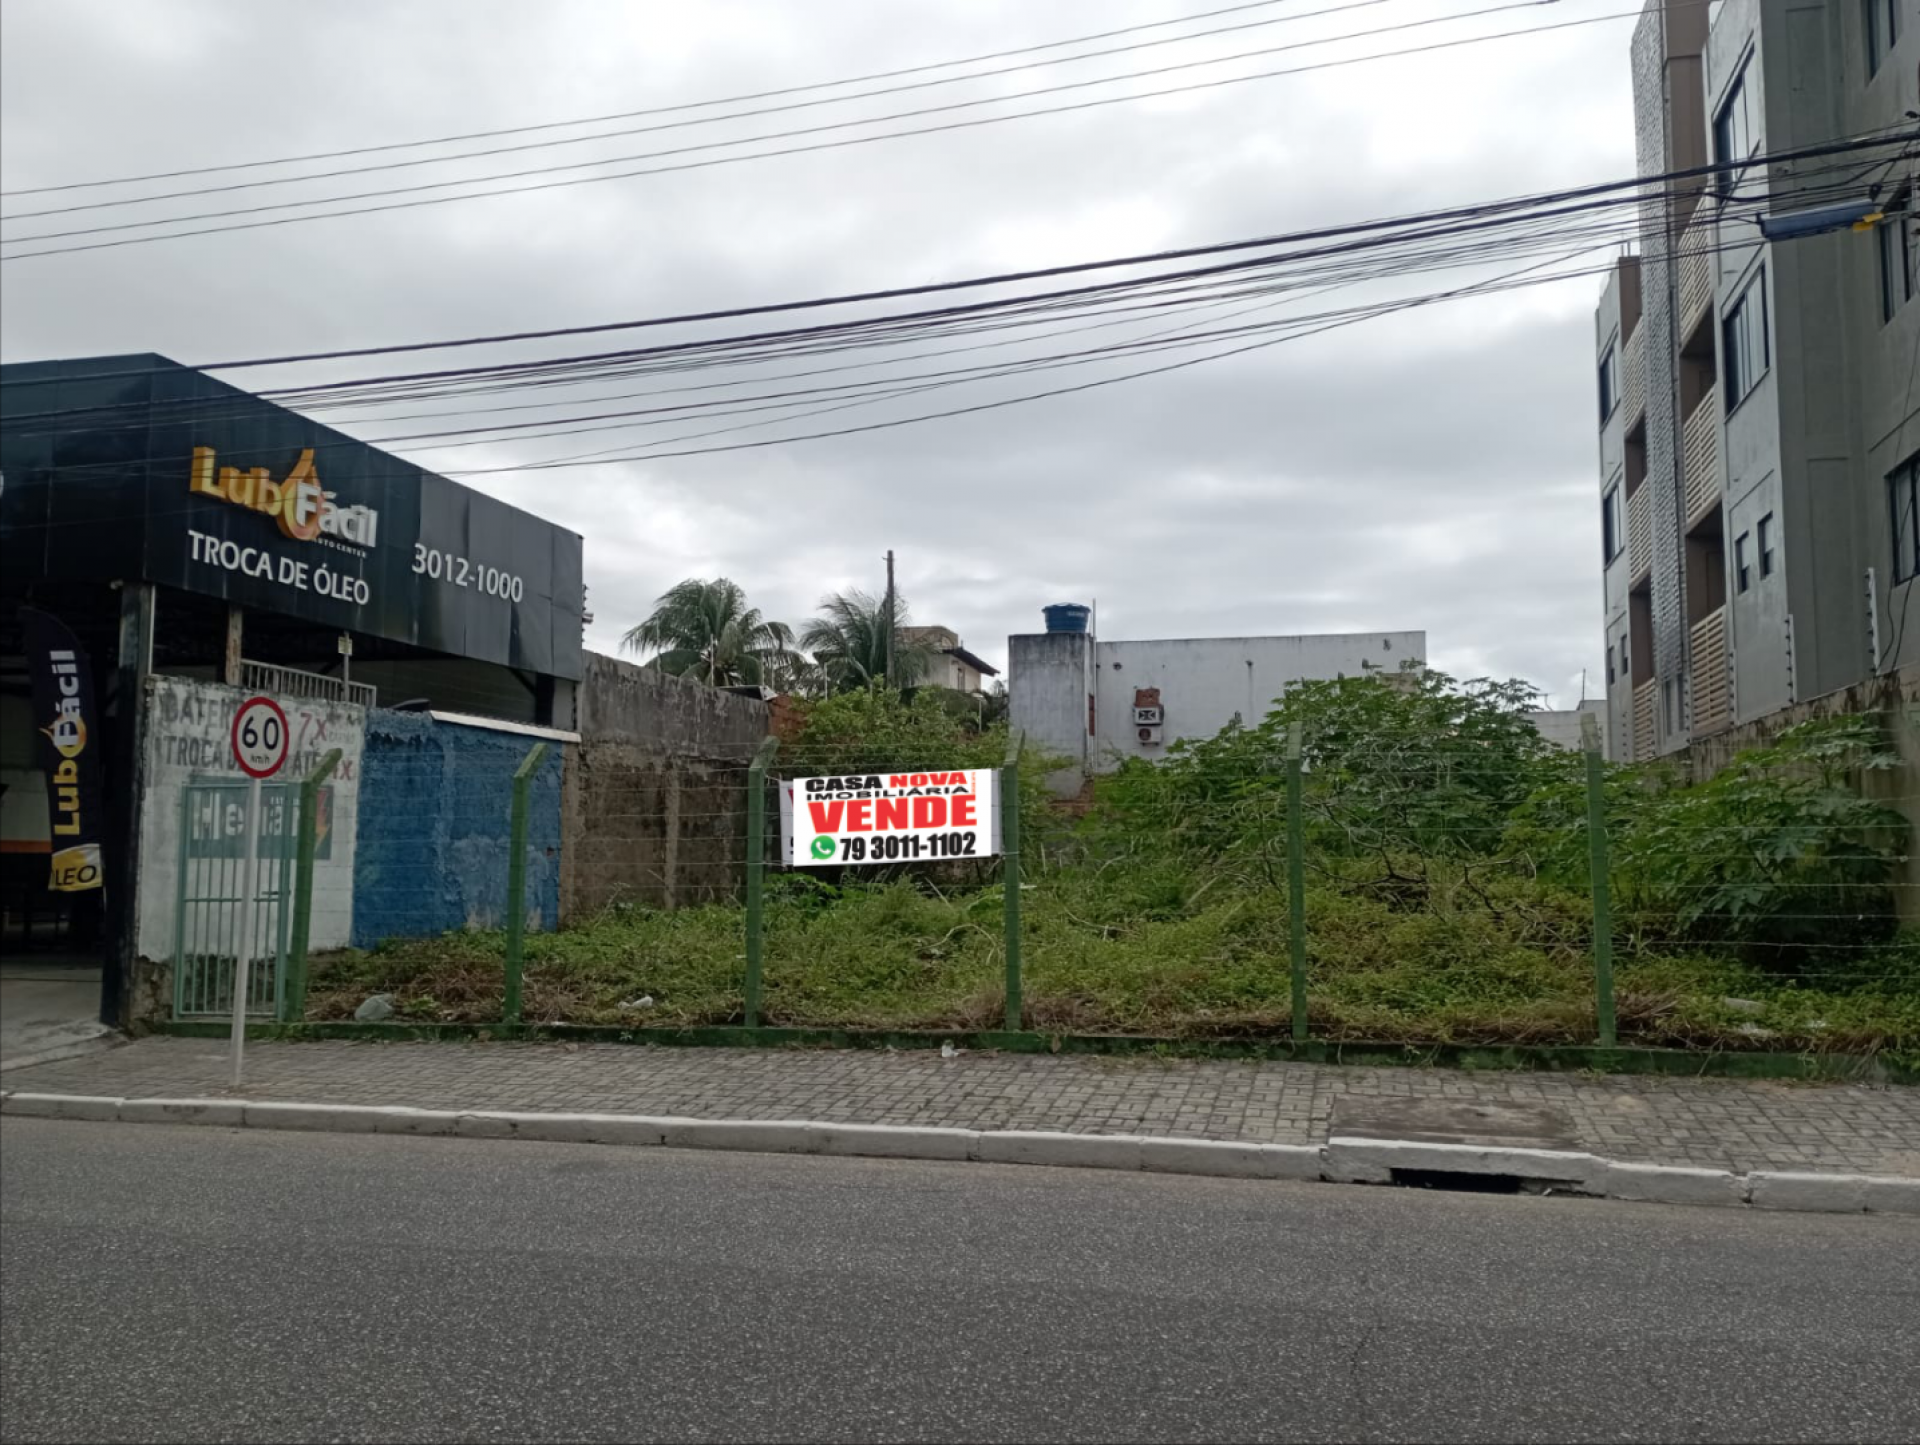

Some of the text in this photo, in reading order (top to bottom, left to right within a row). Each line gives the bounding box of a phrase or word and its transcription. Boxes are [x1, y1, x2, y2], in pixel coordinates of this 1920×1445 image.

[188, 530, 370, 605] TROCA DE ÓLEO
[412, 543, 524, 603] 3012-1000
[242, 715, 279, 751] 60
[163, 735, 223, 769] TROCA
[805, 775, 883, 793] CASA
[889, 771, 968, 788] NOVA
[807, 794, 977, 834] VENDE
[840, 831, 977, 861] 79 3011-1102
